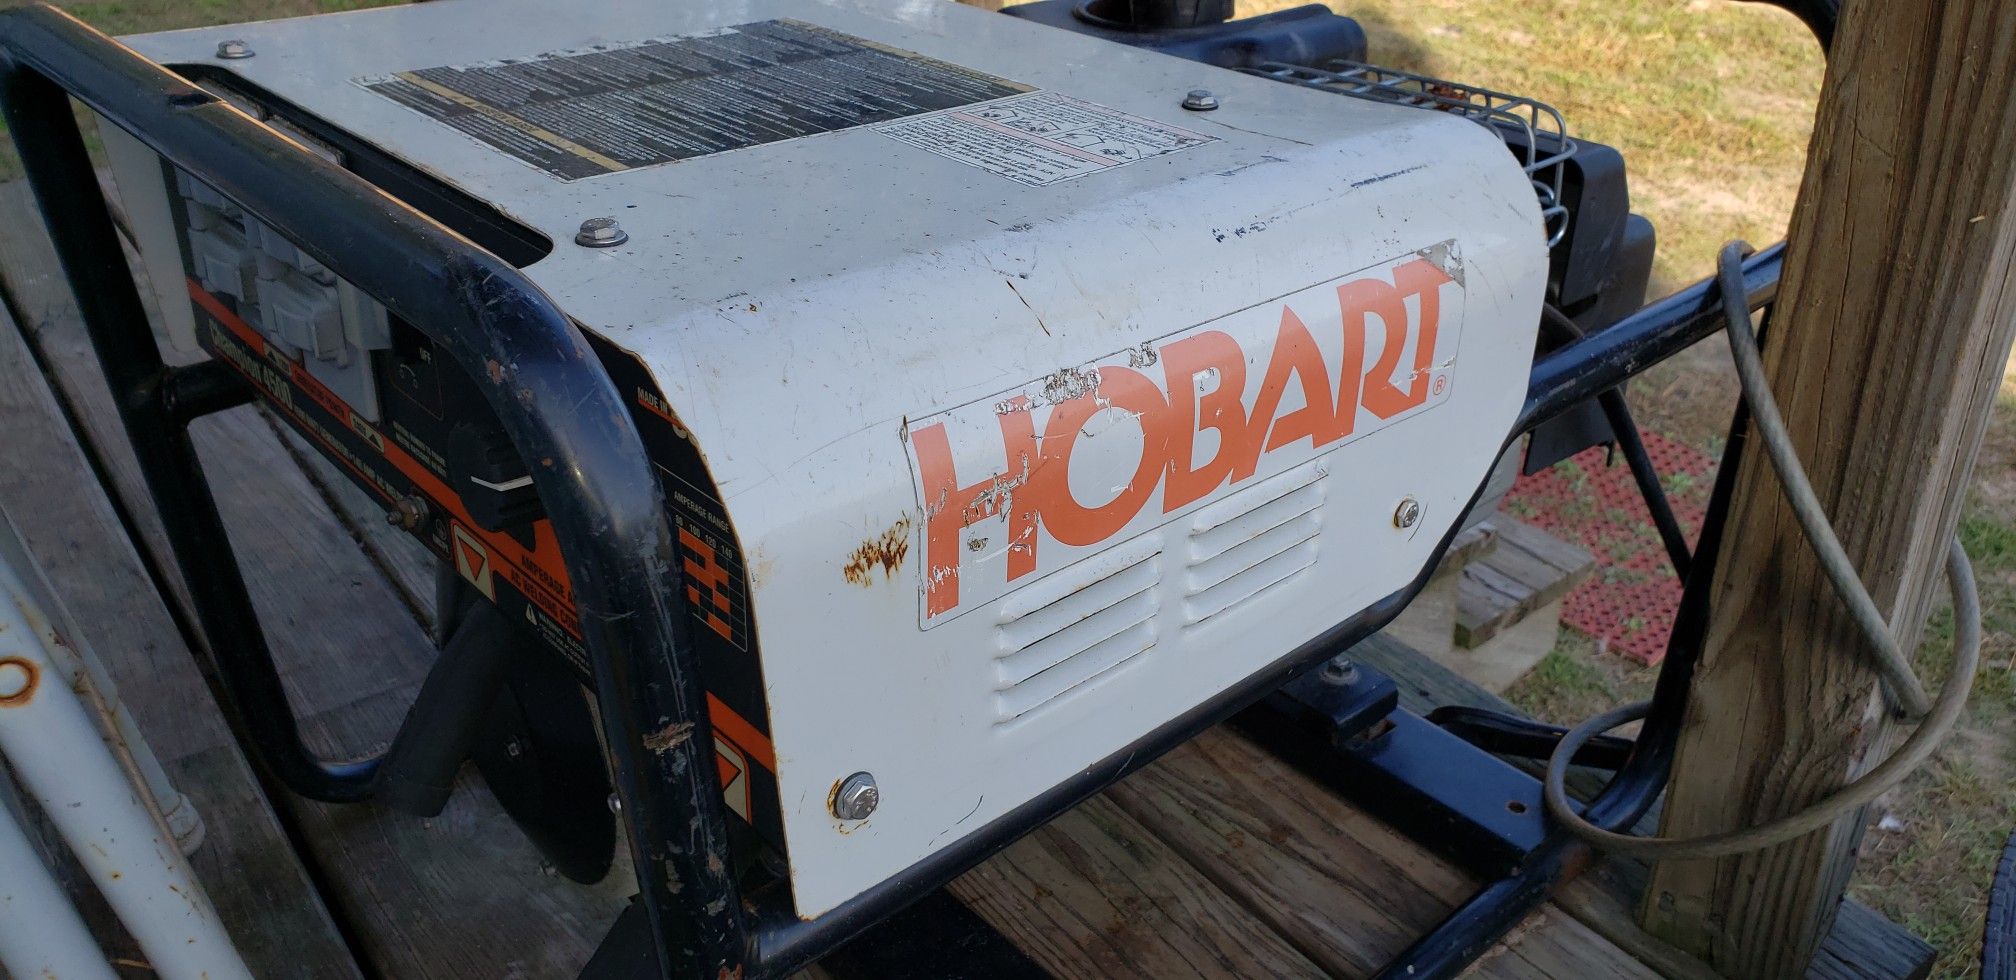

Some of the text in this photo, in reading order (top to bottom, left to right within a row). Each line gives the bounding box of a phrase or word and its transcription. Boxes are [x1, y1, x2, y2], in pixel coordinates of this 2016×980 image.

[637, 385, 659, 409] MADE
[911, 257, 1460, 620] HOBART
[674, 490, 730, 534] AMPERAGE RANGE
